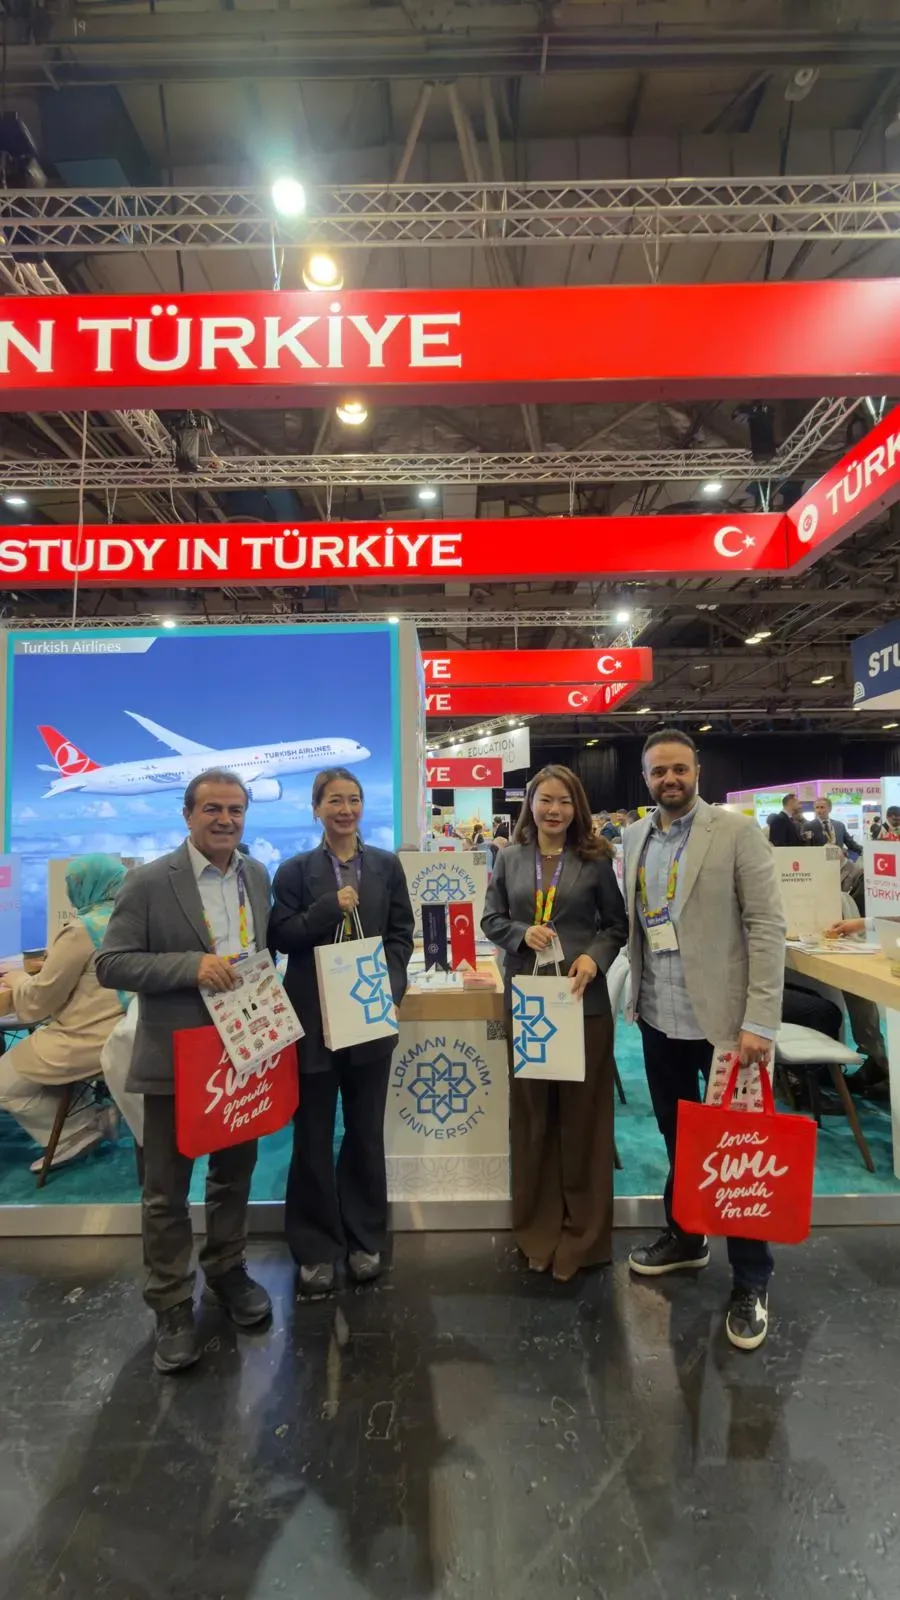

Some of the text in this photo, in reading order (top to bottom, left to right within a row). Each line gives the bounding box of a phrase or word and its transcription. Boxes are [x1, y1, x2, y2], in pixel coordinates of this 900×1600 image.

[78, 301, 462, 373] TÜRKİYE
[0, 526, 463, 572] STUDY IN TÜRKİYE
[21, 638, 122, 654] Turkish Airlines
[264, 745, 331, 759] TURKISH AIRLINES
[467, 737, 515, 758] EDUCATION
[410, 861, 447, 897] LOKMAN
[391, 1036, 493, 1089] LOKMAN HEKIM
[223, 1077, 274, 1126] growth
[230, 1095, 273, 1133] for all
[398, 1105, 486, 1140] UNIVERSITY
[716, 1130, 769, 1149] loves
[715, 1180, 774, 1208] growth
[721, 1202, 772, 1219] for all
